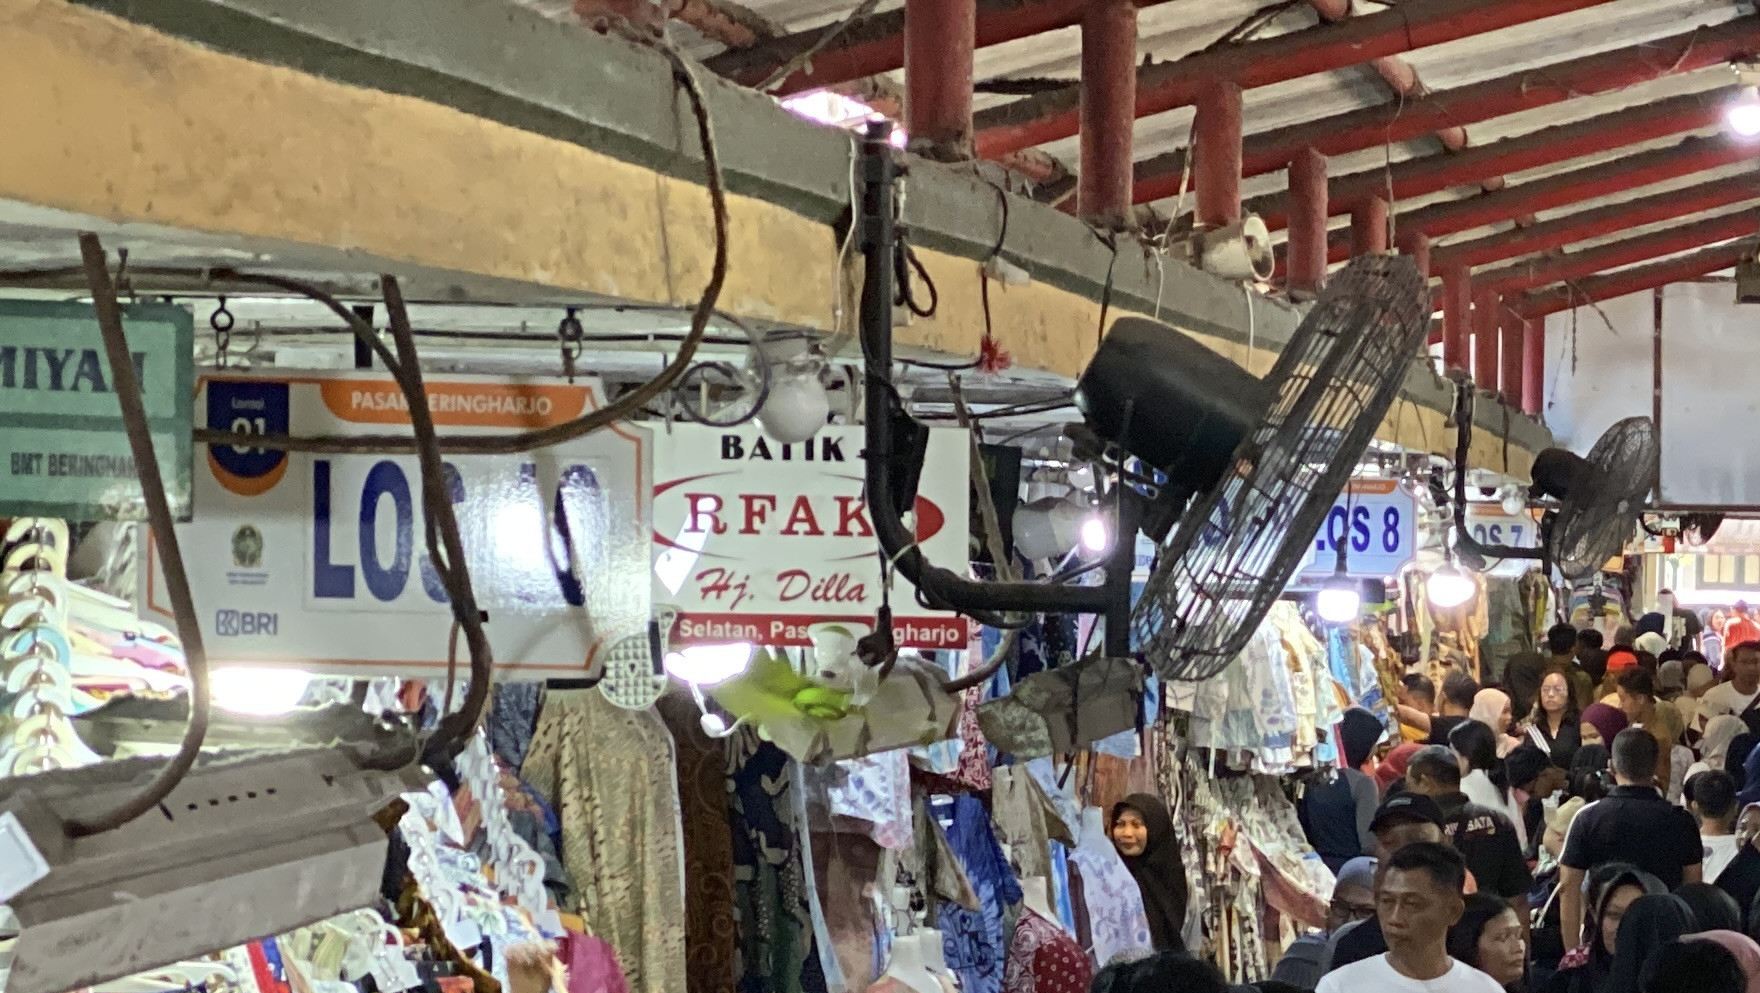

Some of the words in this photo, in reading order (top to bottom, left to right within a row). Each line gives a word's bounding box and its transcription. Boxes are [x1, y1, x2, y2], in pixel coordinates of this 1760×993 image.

[427, 393, 553, 416] ERINGHARJO
[684, 493, 874, 537] RFAK
[1316, 505, 1371, 553] OS
[1383, 506, 1400, 553] 8
[1473, 523, 1502, 548] OS
[696, 567, 755, 610] Hj.
[777, 568, 868, 605] Dilla
[241, 611, 278, 636] BRI
[679, 619, 763, 641] Selatan,
[770, 620, 810, 640] Pas
